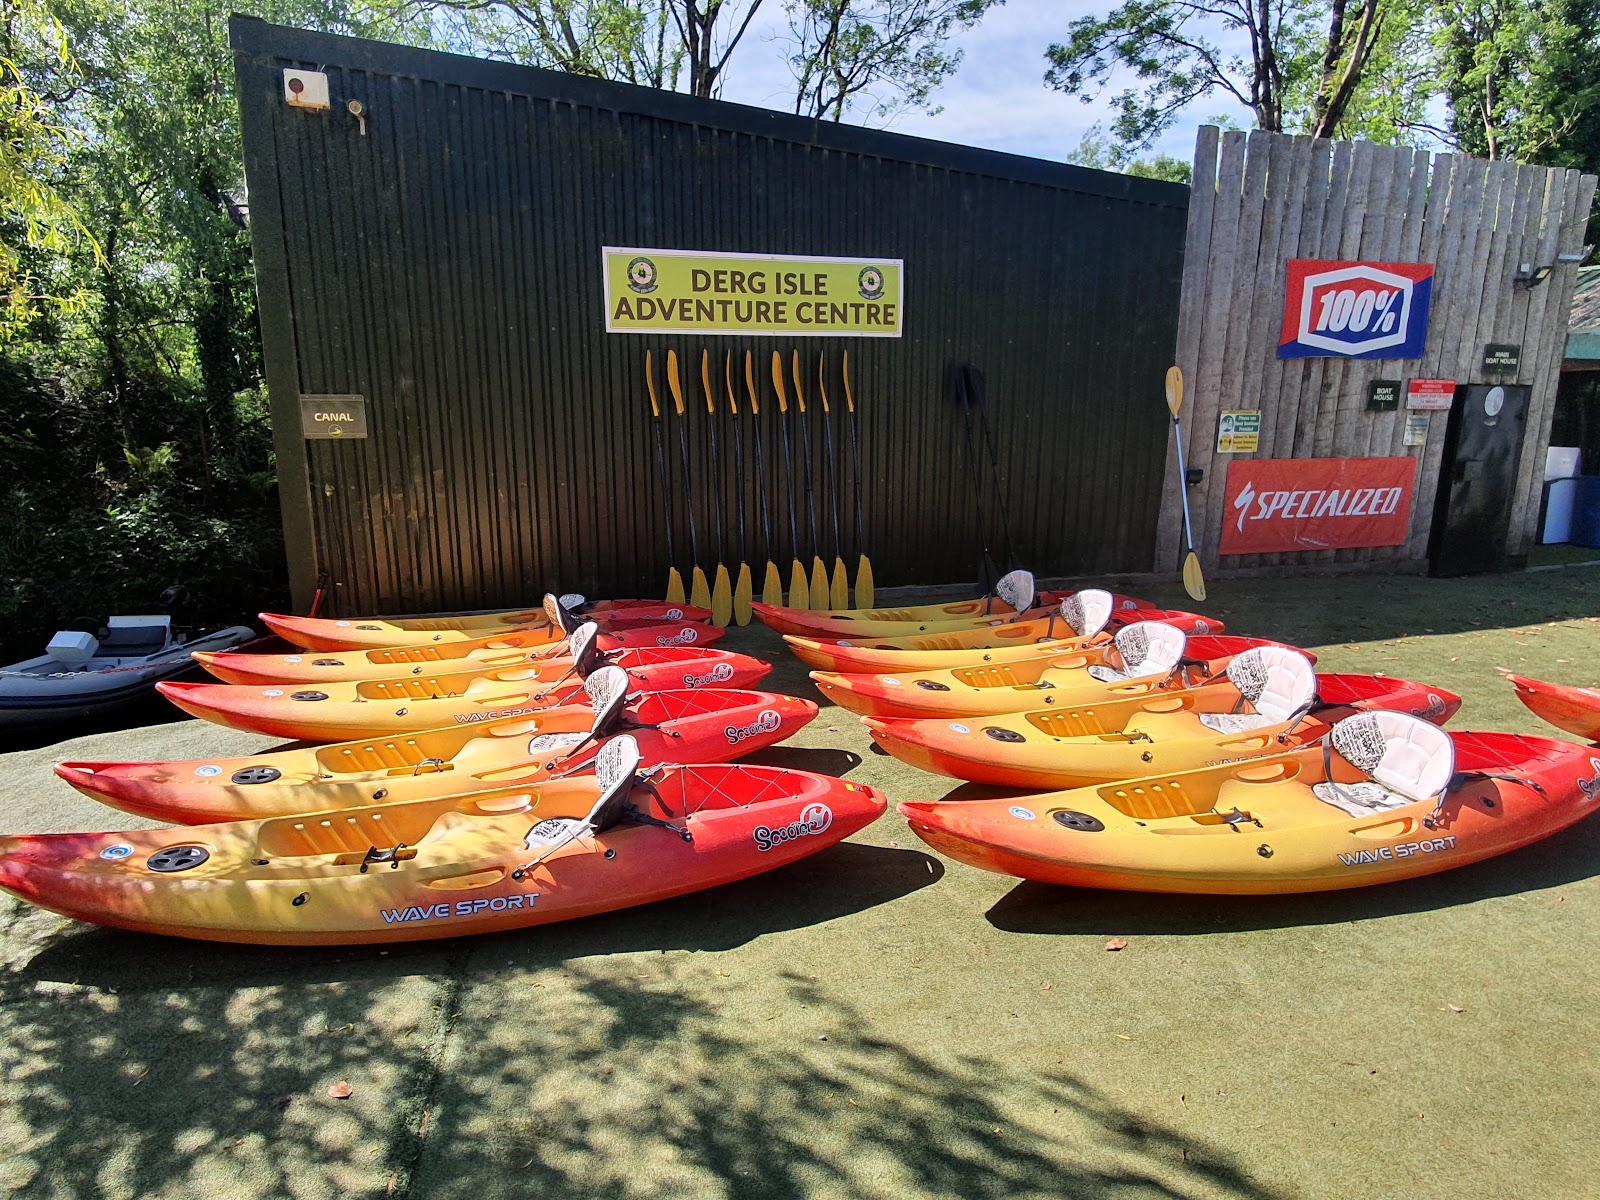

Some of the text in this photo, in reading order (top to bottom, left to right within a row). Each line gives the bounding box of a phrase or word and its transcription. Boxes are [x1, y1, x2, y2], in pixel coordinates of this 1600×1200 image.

[691, 269, 828, 295] DERG ISLE
[613, 297, 896, 325] ADVENTURE CENTRE
[1316, 289, 1399, 332] 100%
[314, 413, 355, 422] CANAL
[1250, 487, 1402, 520] SPECIALIZED
[454, 711, 498, 723] WAVE
[725, 722, 769, 744] Scooter
[753, 821, 815, 851] Scooter
[1337, 835, 1457, 866] WAVE SPORT
[380, 893, 540, 923] WAVE SPORT
